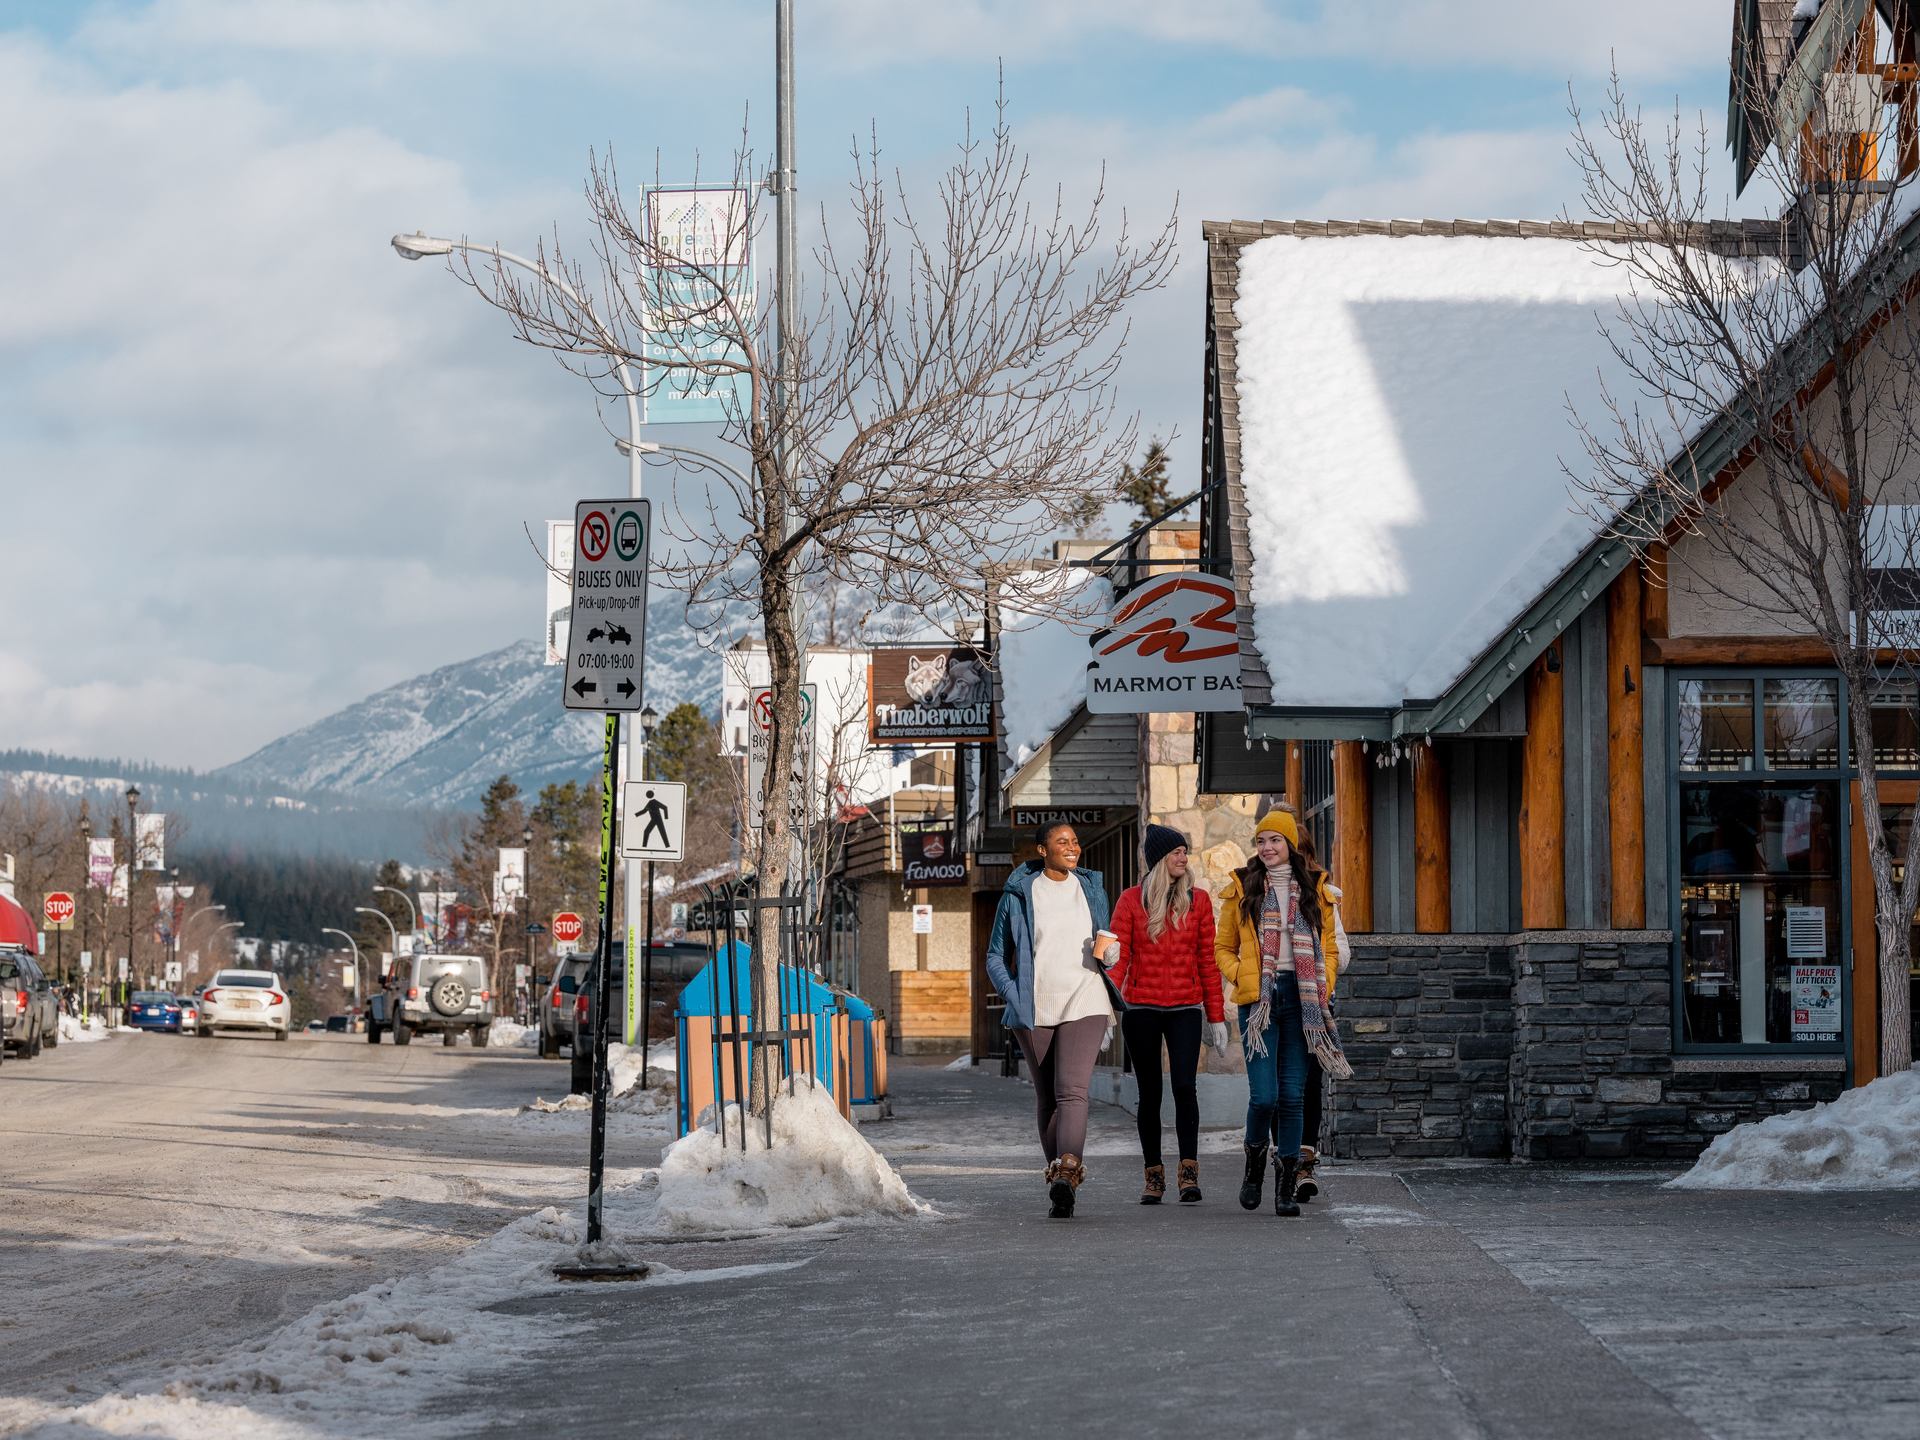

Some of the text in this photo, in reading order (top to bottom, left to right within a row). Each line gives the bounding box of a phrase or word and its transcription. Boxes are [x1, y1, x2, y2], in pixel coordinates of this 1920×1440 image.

[578, 570, 643, 588] BUSES ONLY
[578, 653, 634, 669] 07:00-19:00
[1094, 676, 1196, 693] MARMOT
[876, 702, 990, 726] Timberwolf
[1017, 810, 1101, 825] ENTRANCE
[46, 901, 73, 914] STOP
[555, 921, 581, 933] STOP
[1796, 968, 1836, 977] HALF PRICE
[1796, 976, 1837, 985] LIFT TICKETS
[1796, 1032, 1837, 1041] SOLD HERE
